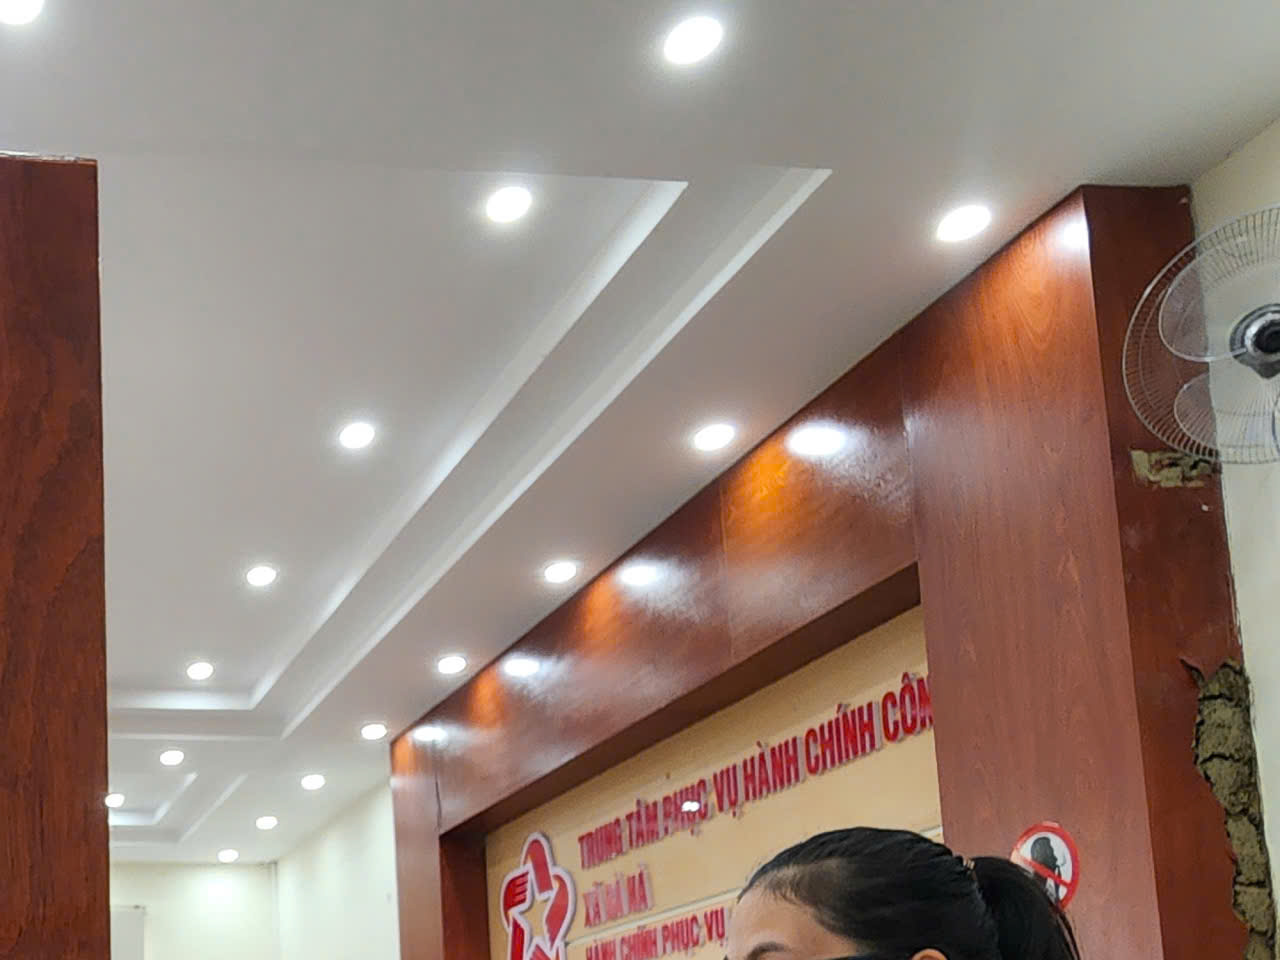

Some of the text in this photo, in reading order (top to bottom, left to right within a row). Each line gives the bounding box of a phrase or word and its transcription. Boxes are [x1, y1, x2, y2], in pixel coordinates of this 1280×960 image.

[625, 798, 659, 849] TÂM
[713, 764, 738, 818] VỤ
[743, 737, 800, 800] HÀNH
[805, 704, 876, 776] CHÍNH
[662, 914, 700, 955] PHỤC
